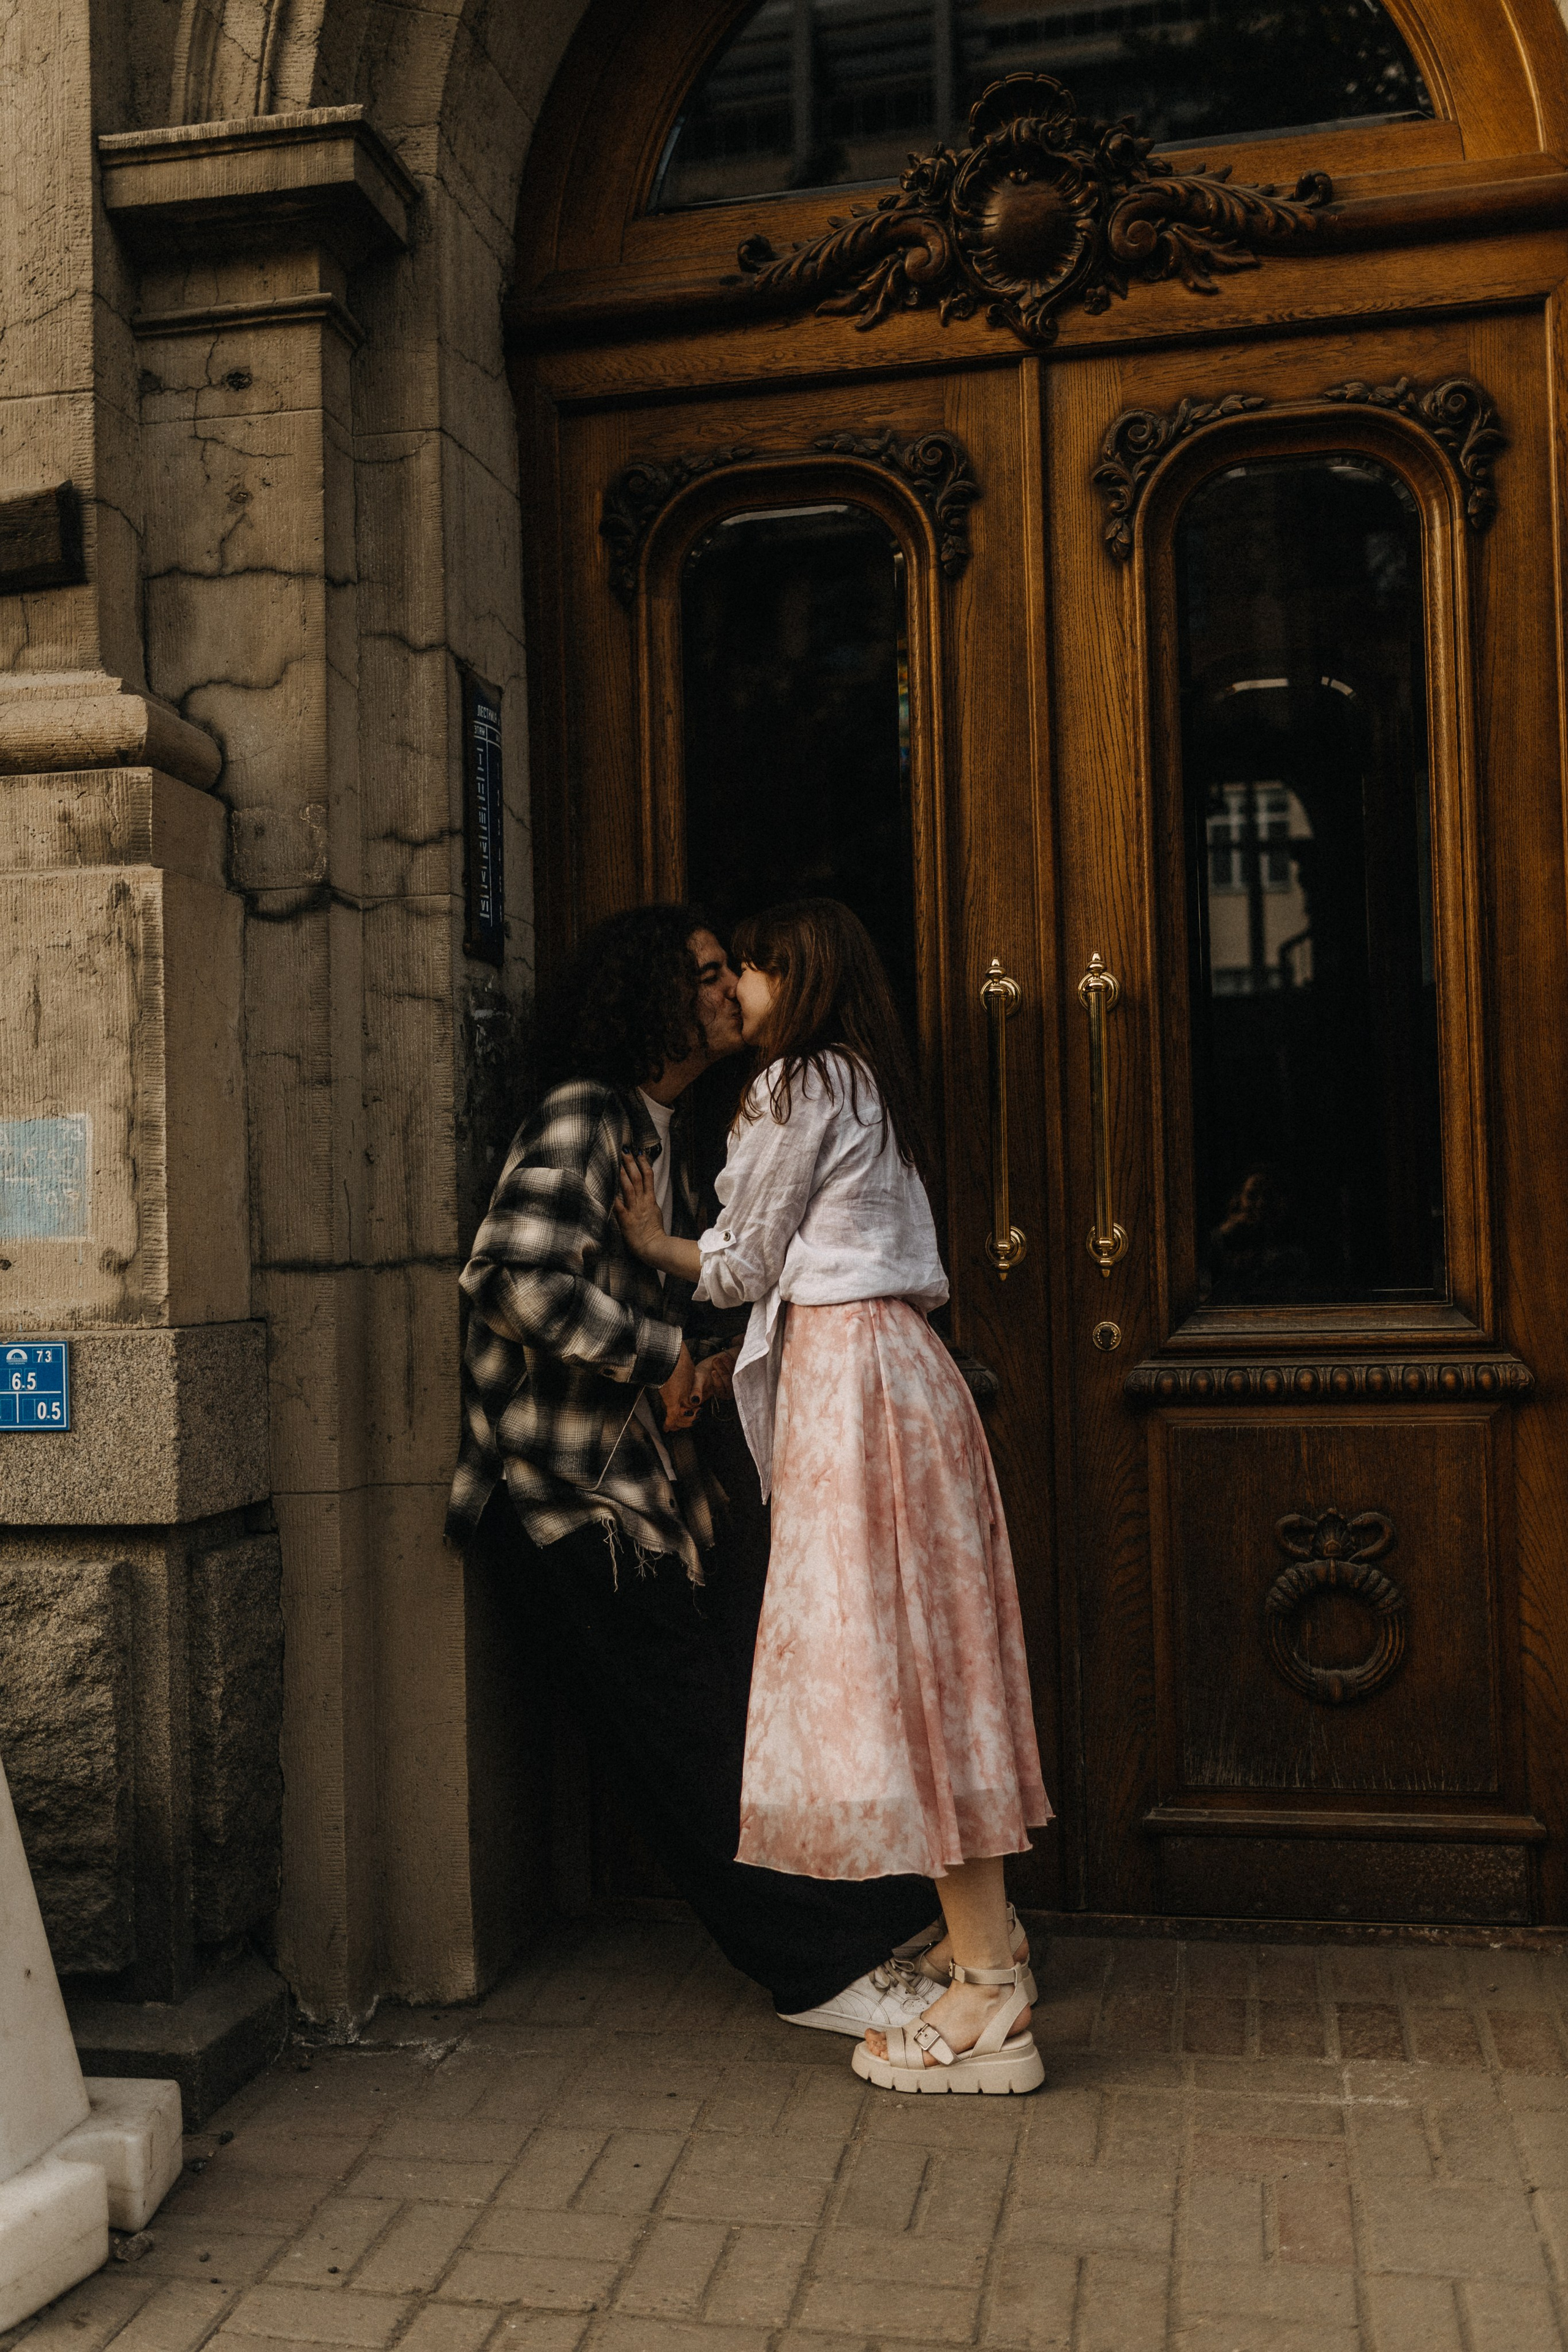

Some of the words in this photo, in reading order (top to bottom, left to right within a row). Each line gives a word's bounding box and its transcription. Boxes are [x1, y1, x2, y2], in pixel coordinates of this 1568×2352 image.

[36, 1350, 51, 1363] 73
[12, 1372, 36, 1390] 6.5
[37, 1401, 61, 1420] 0.5
